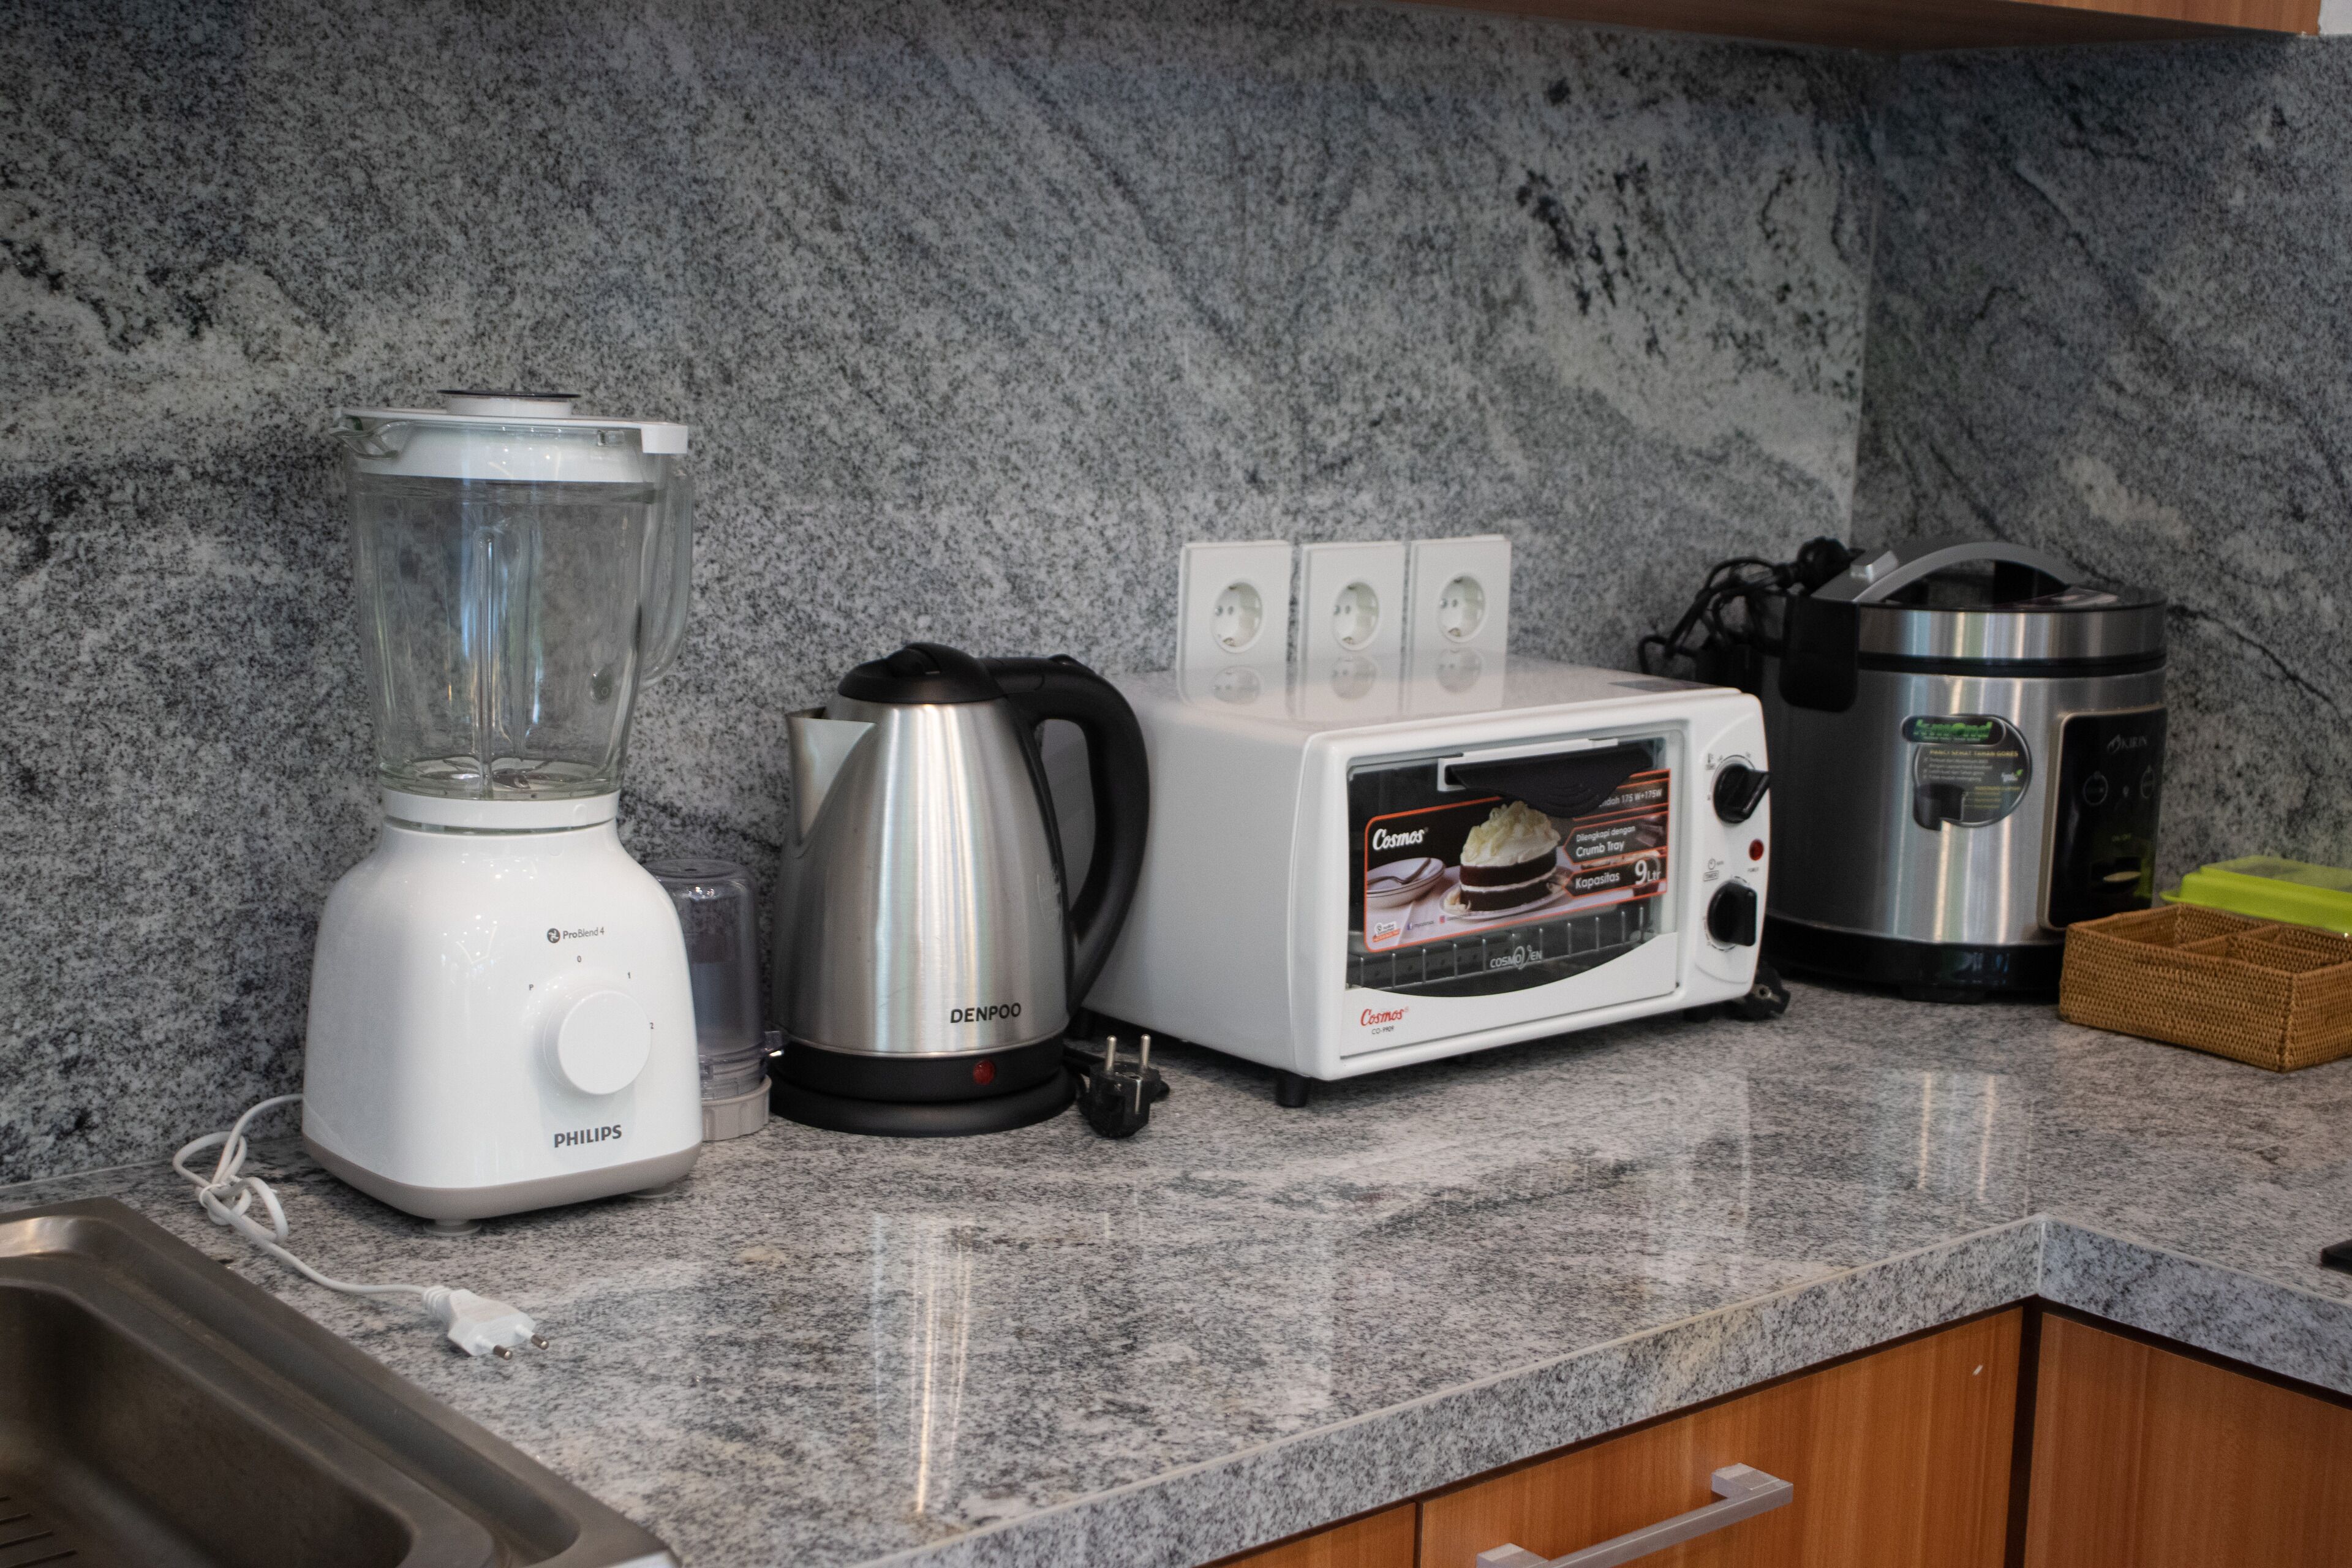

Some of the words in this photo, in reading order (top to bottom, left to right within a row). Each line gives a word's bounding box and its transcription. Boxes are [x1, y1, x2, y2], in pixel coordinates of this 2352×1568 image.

[1622, 794, 1634, 803] 175
[1373, 829, 1425, 850] Cosmos
[1576, 829, 1610, 842] Dilengkapi
[1611, 826, 1635, 836] dengan
[1576, 843, 1605, 857] Crumb
[1607, 841, 1625, 851] Tray
[1575, 872, 1620, 889] Kapasitas
[563, 927, 598, 940] ProBlend
[600, 927, 605, 935] 4
[950, 1002, 1021, 1023] DENPOO
[1361, 1008, 1404, 1026] Cosmos
[554, 1125, 622, 1148] PHILIPS
